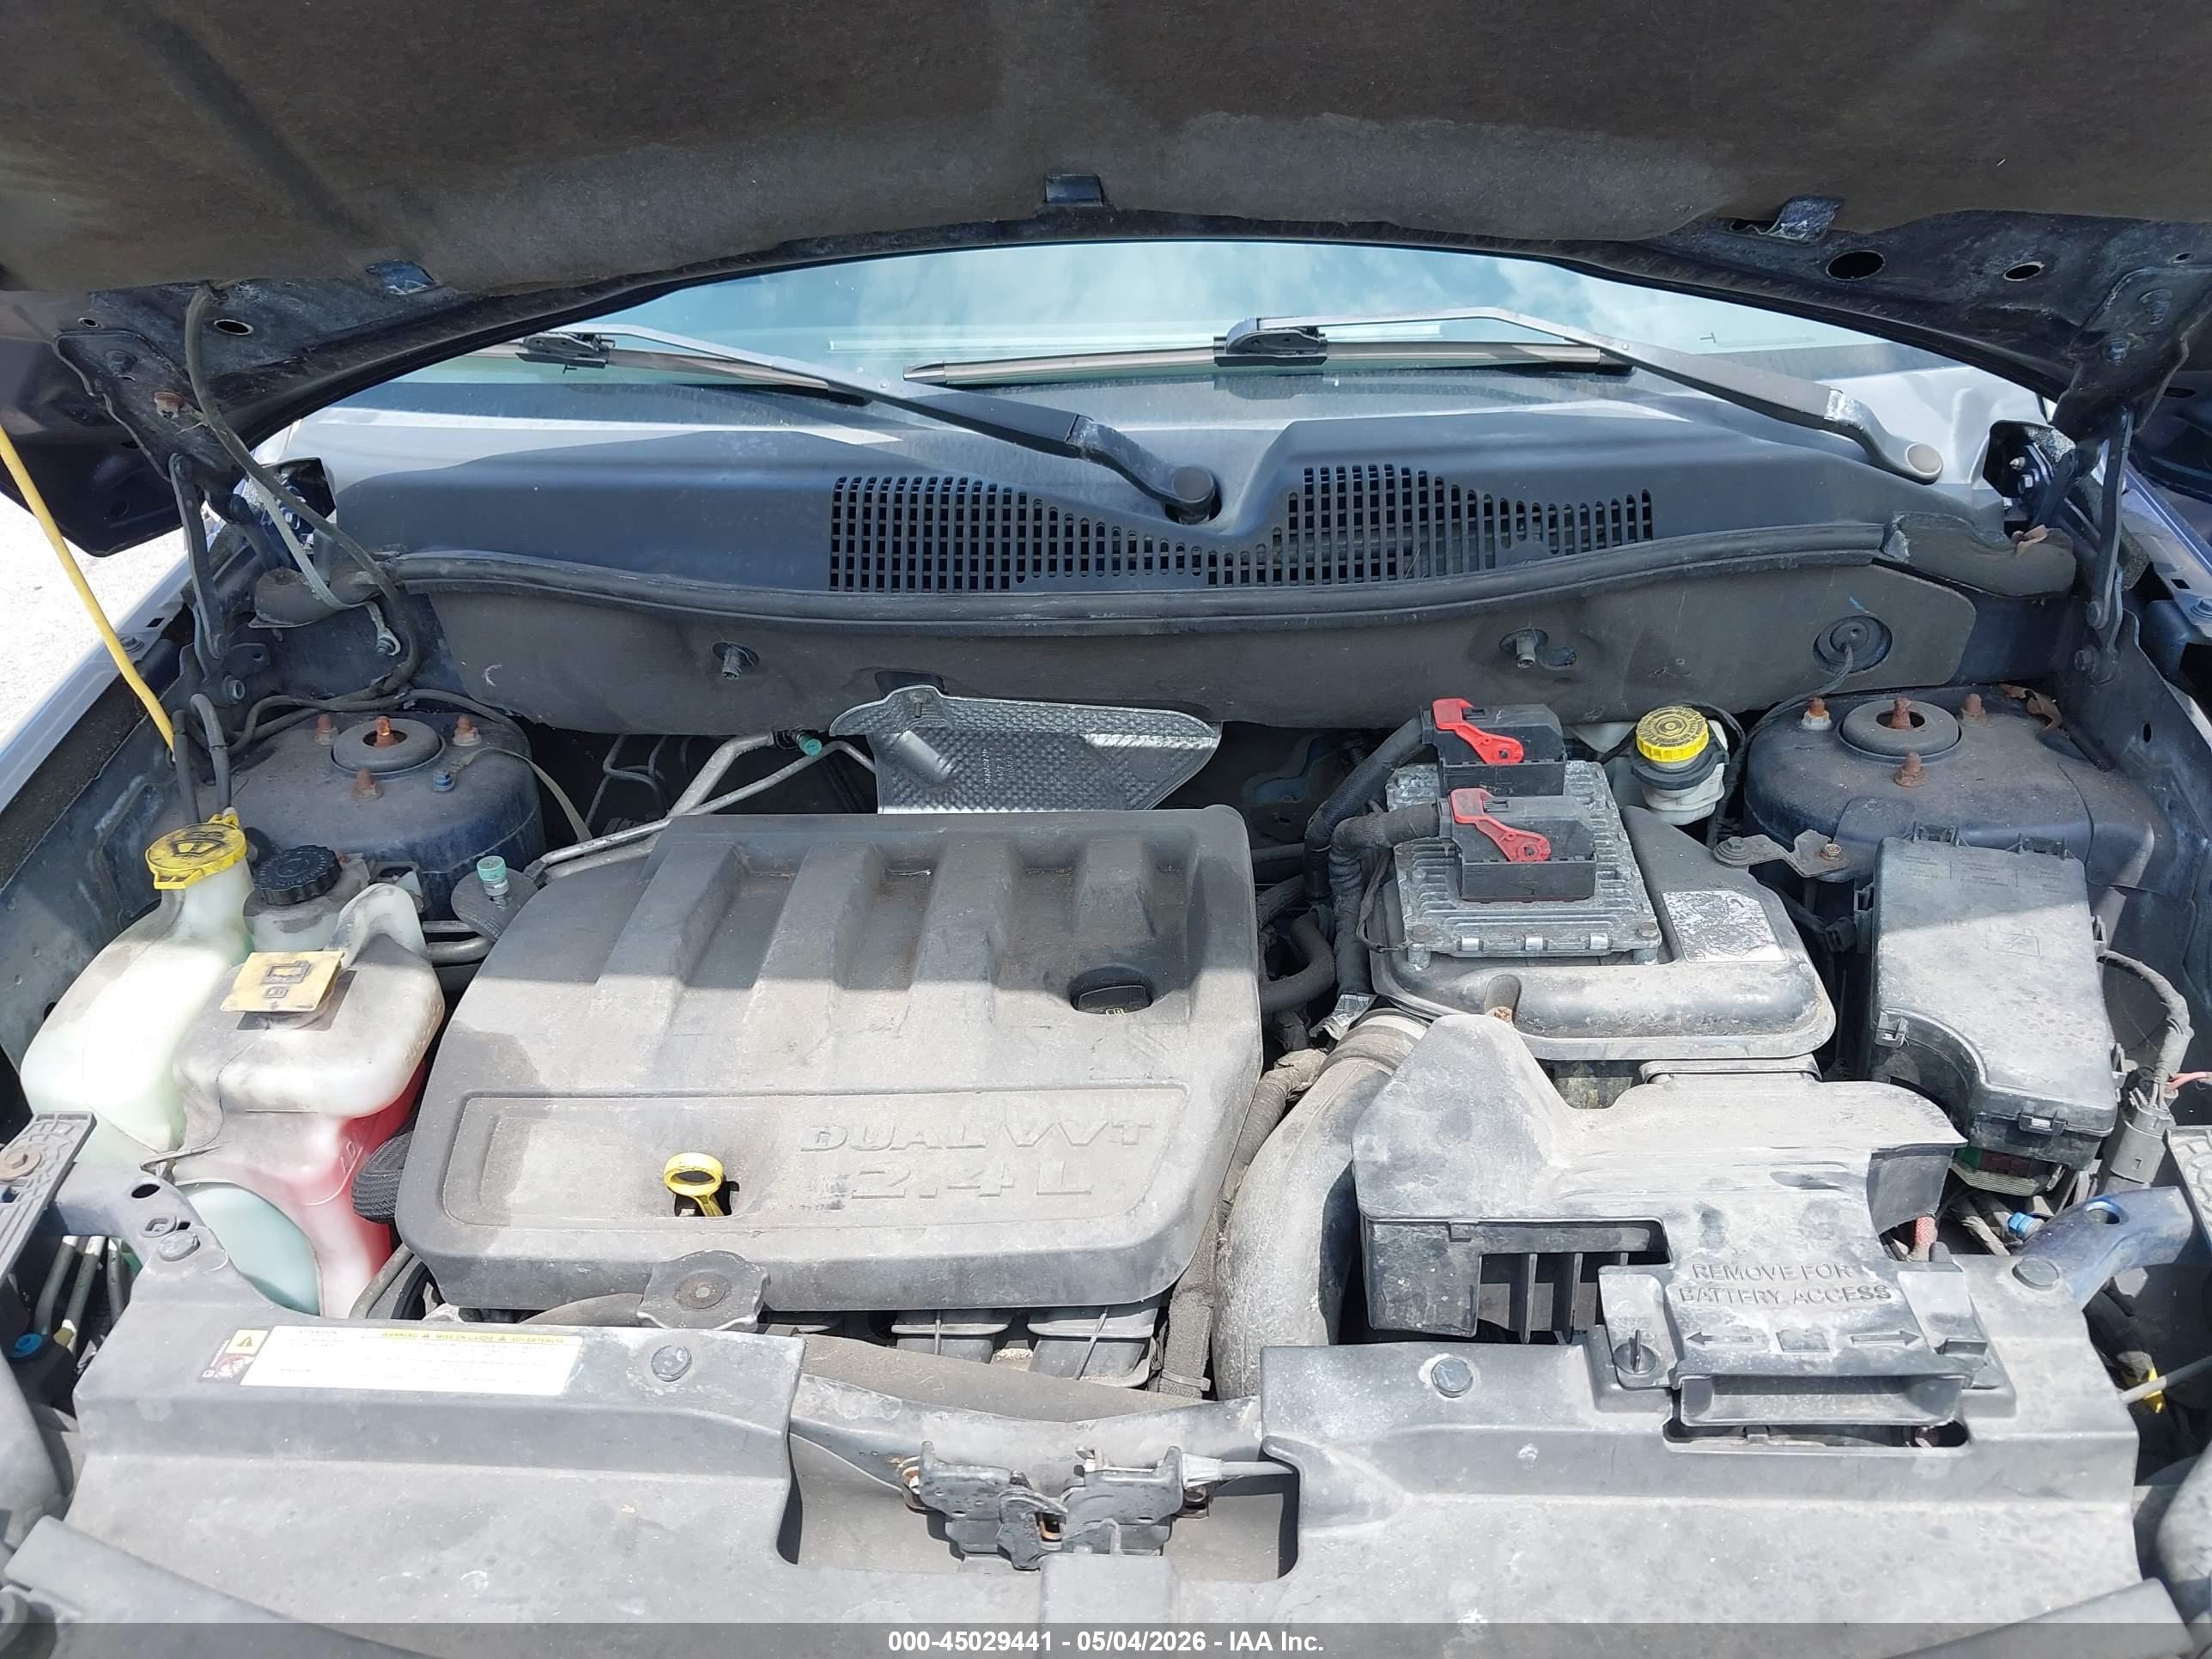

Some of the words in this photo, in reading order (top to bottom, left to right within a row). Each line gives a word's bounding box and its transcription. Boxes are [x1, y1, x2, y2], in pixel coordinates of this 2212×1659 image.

[799, 1123, 988, 1152] DUAL
[999, 1120, 1152, 1147] VVT
[850, 1159, 1093, 1200] 2.4L
[1691, 1263, 1795, 1281] REMOVE
[1800, 1262, 1855, 1280] FOR
[1678, 1286, 1782, 1304] BATTERY
[1792, 1284, 1893, 1304] ACCESS
